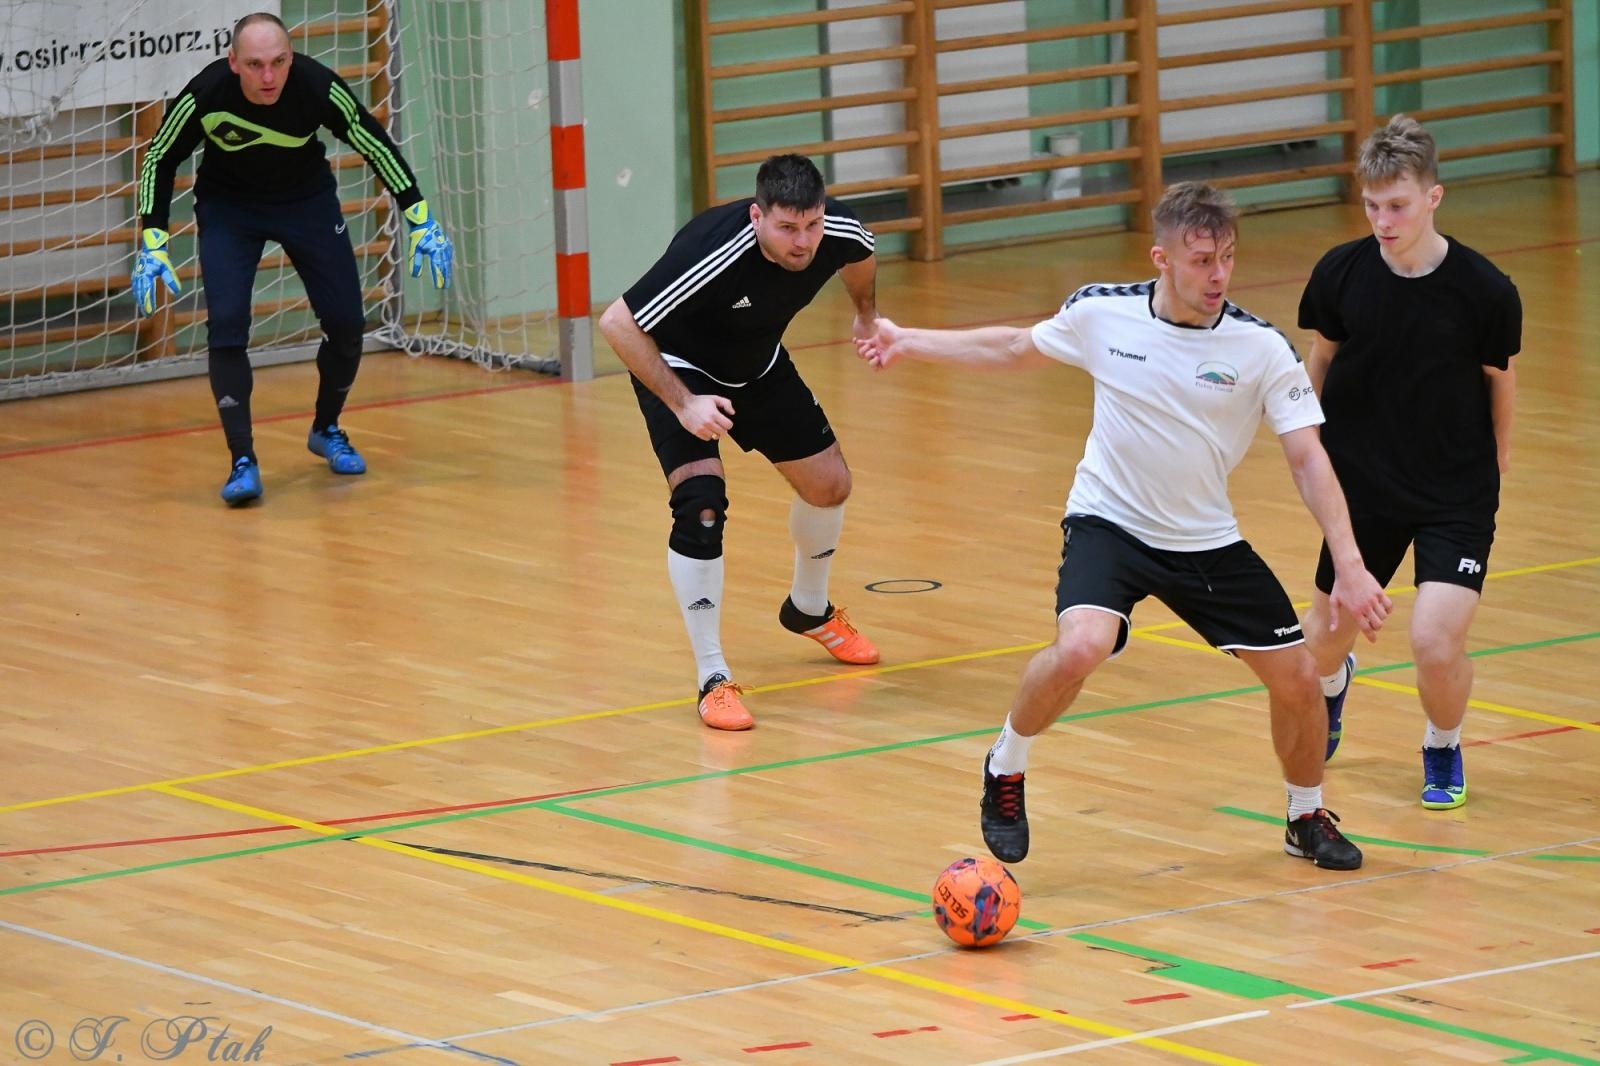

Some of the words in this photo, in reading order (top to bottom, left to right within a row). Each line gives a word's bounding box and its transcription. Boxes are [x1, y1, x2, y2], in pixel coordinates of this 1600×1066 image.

[0, 20, 238, 72] .osir-raciborz.p
[1116, 349, 1147, 362] hummel
[938, 881, 969, 919] SELECT
